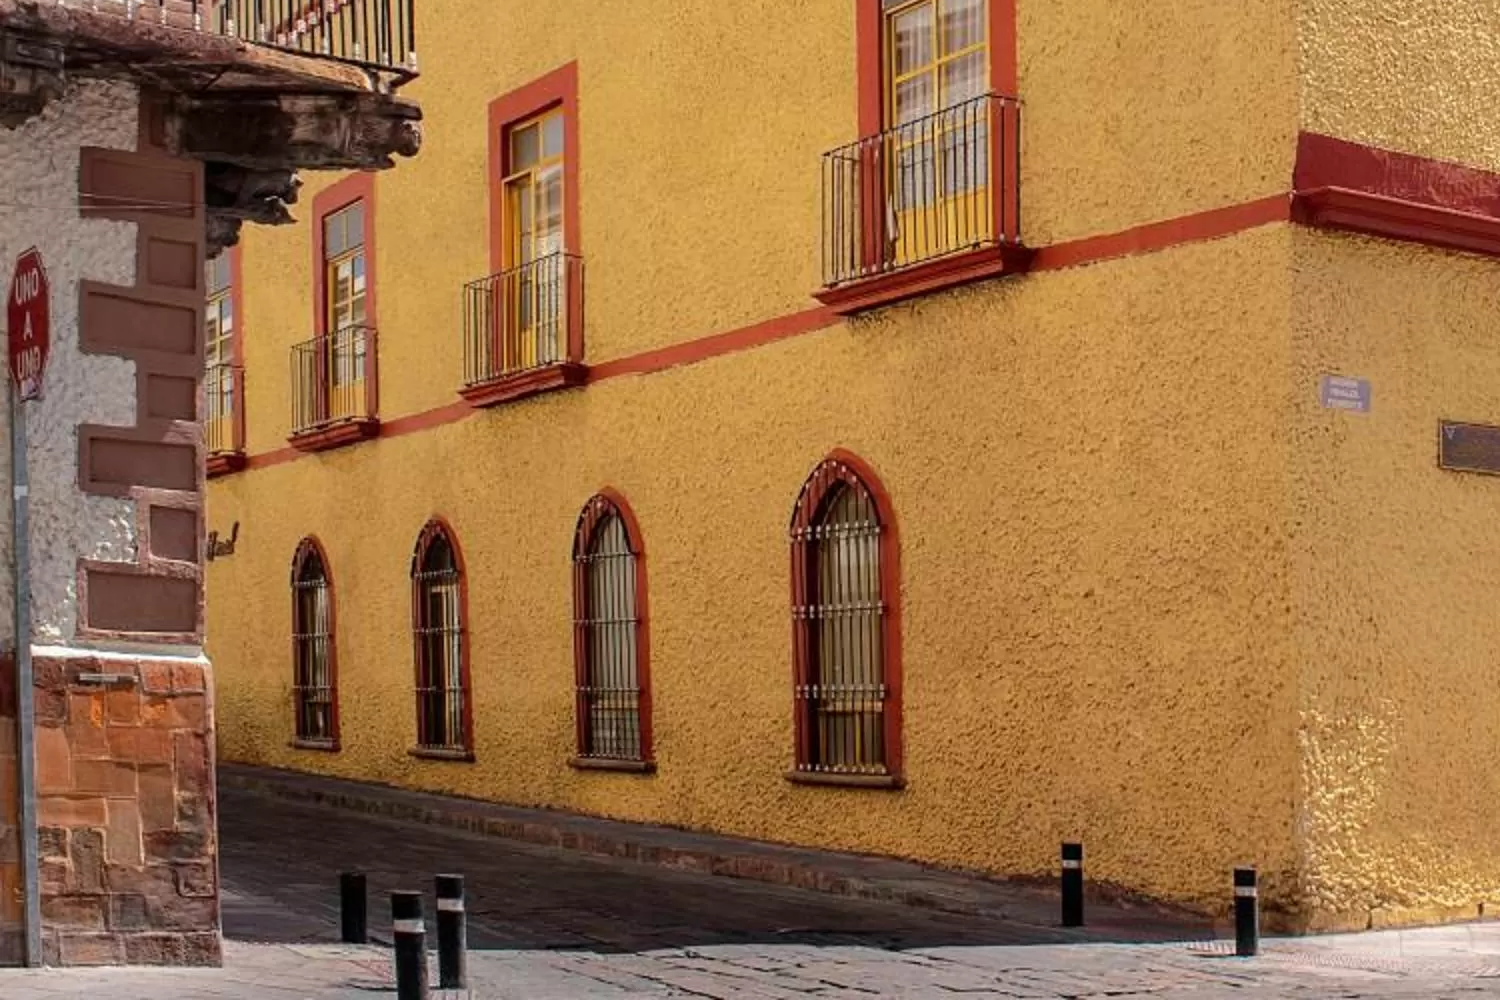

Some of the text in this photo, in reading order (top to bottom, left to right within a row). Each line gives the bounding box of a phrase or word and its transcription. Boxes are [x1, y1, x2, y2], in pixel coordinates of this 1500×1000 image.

[15, 267, 39, 305] UNO
[23, 311, 33, 341] A
[17, 346, 41, 379] UNO
